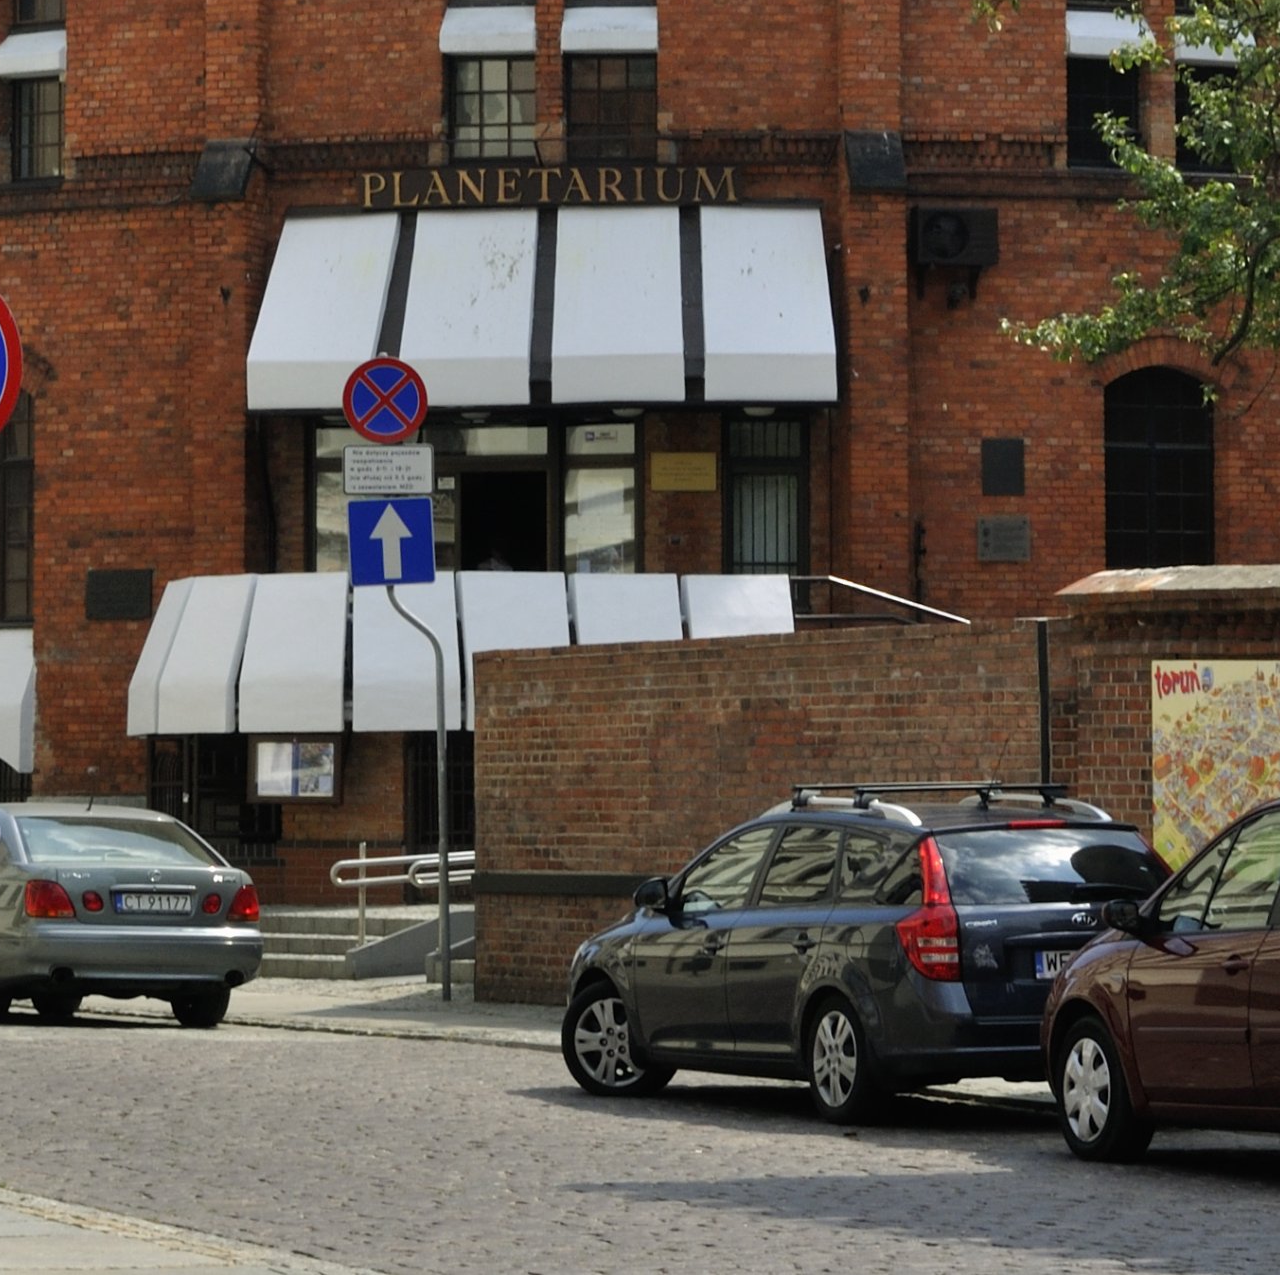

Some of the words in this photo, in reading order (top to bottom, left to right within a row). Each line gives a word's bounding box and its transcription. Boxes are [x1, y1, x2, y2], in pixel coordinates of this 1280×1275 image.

[362, 166, 739, 207] PLANETARIUM
[125, 894, 143, 910] CT
[148, 894, 189, 910] 91177
